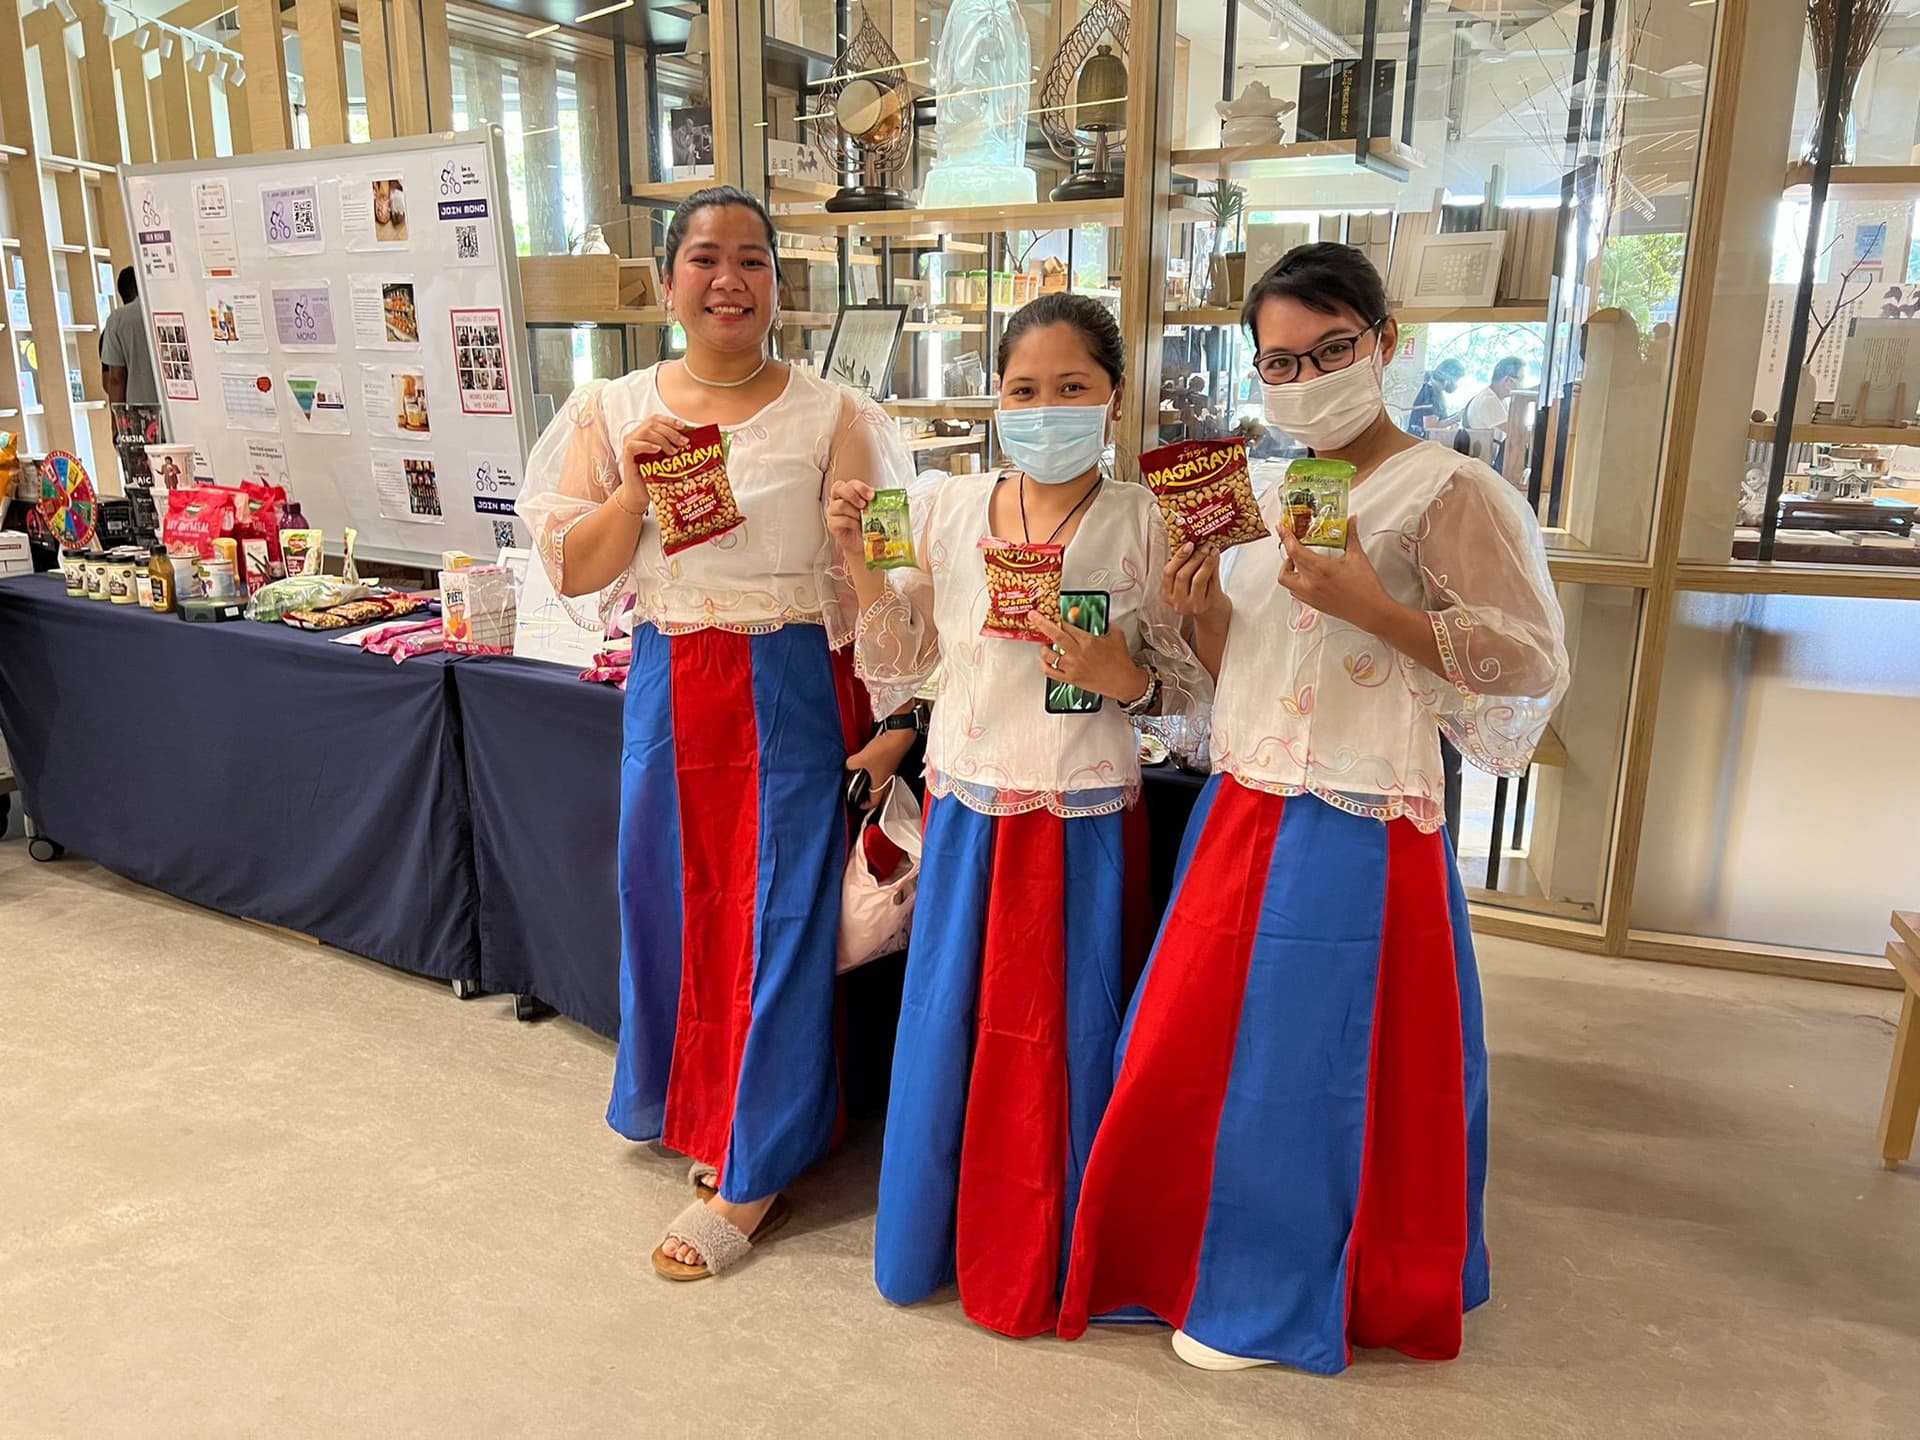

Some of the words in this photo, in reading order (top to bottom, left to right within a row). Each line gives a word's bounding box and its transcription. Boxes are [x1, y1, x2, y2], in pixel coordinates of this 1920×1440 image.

[441, 206, 462, 216] JOIN
[464, 204, 485, 214] MONO
[639, 443, 723, 478] NAGARAYA
[1147, 444, 1246, 489] NAGARAYA
[477, 501, 498, 510] JOIN
[500, 503, 514, 511] MON
[1191, 518, 1206, 530] HOT
[1213, 503, 1233, 518] SPICY
[1194, 519, 1220, 536] CRACKER
[1219, 510, 1235, 522] NUTS
